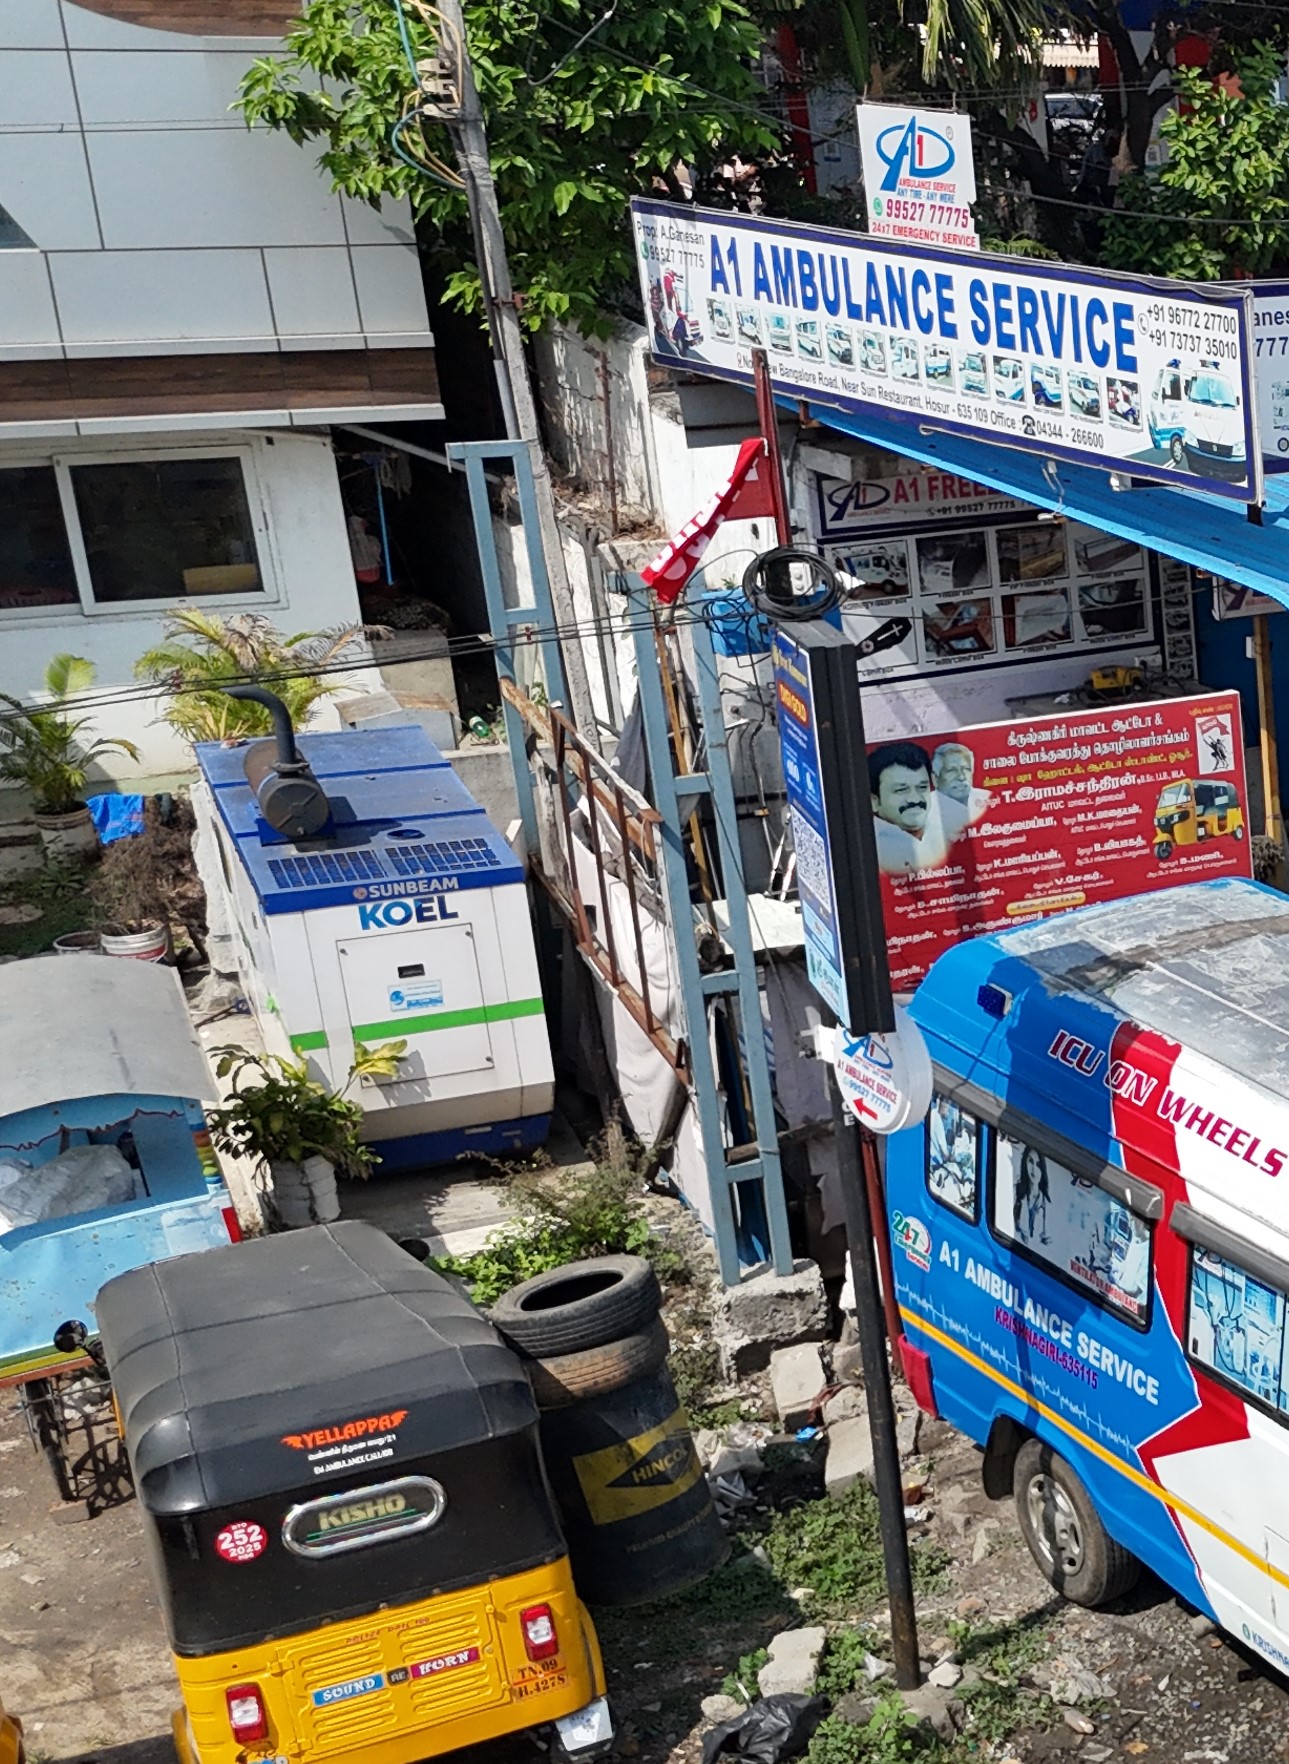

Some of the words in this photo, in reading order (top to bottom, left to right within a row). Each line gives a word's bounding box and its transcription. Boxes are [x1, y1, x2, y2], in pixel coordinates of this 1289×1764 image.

[933, 182, 956, 194] SERVICE
[886, 198, 925, 222] 99527
[929, 204, 969, 229] 77775
[872, 222, 890, 234] 24x7
[892, 224, 940, 243] EMERGENCY
[942, 232, 976, 248] SERVICE
[650, 245, 675, 263] 99527
[678, 249, 705, 269] 77775
[710, 234, 742, 297] A1
[753, 242, 959, 339] AMBULANCE
[970, 278, 1138, 374] SERVICE
[1147, 303, 1165, 323] +91
[1168, 306, 1201, 329] 96772
[1204, 311, 1237, 335] 27700
[1149, 329, 1167, 348] +91
[1170, 331, 1202, 354] 73737
[1205, 337, 1238, 360] 35010
[780, 363, 817, 385] Bangalore
[842, 378, 859, 393] Near
[861, 382, 876, 398] Sun
[925, 396, 950, 414] Hosur
[957, 403, 972, 419] 635
[974, 407, 988, 423] 109
[990, 409, 1016, 429] Office
[1036, 421, 1063, 440] 04344
[1072, 428, 1104, 449] 266600
[893, 478, 920, 505] A1
[987, 499, 1016, 511] 77775
[1041, 800, 1064, 812] AITUC
[369, 876, 459, 899] SUNBEAM
[358, 895, 459, 931] KOEL
[1048, 1028, 1105, 1077] ICU
[1105, 1060, 1158, 1106] ON
[1157, 1085, 1289, 1178] WHEELS
[939, 1240, 961, 1274] A1
[964, 1261, 1074, 1349] AMBULANCE
[1077, 1331, 1160, 1406] SERVICE
[994, 1304, 1100, 1391] KRISHNAGIRI-635115
[299, 1415, 395, 1449] YELLAPPA
[318, 1493, 406, 1531] KISHO
[218, 1524, 263, 1550] 252
[229, 1542, 262, 1559] 2025
[419, 1651, 470, 1676] HORN
[517, 1658, 558, 1679] TN.09
[322, 1676, 378, 1702] SOUND
